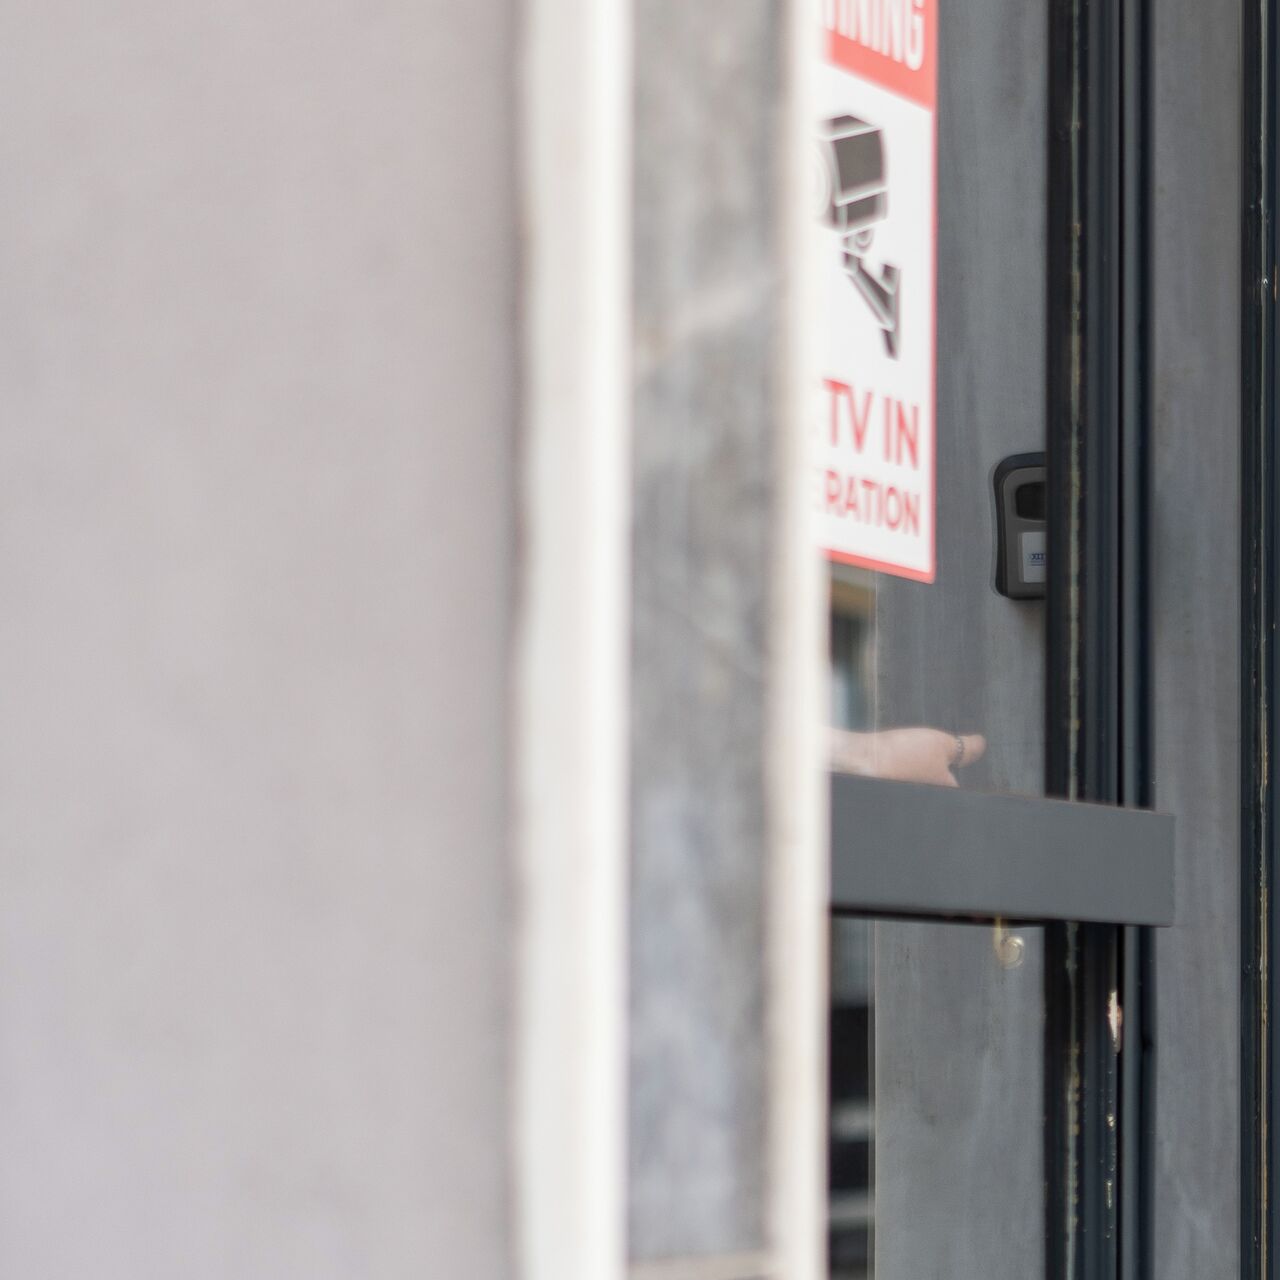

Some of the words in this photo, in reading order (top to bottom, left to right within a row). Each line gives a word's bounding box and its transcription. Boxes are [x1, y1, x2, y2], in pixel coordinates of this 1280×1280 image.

[822, 377, 873, 454] TV
[883, 394, 920, 471] IN
[823, 467, 921, 538] RATION
